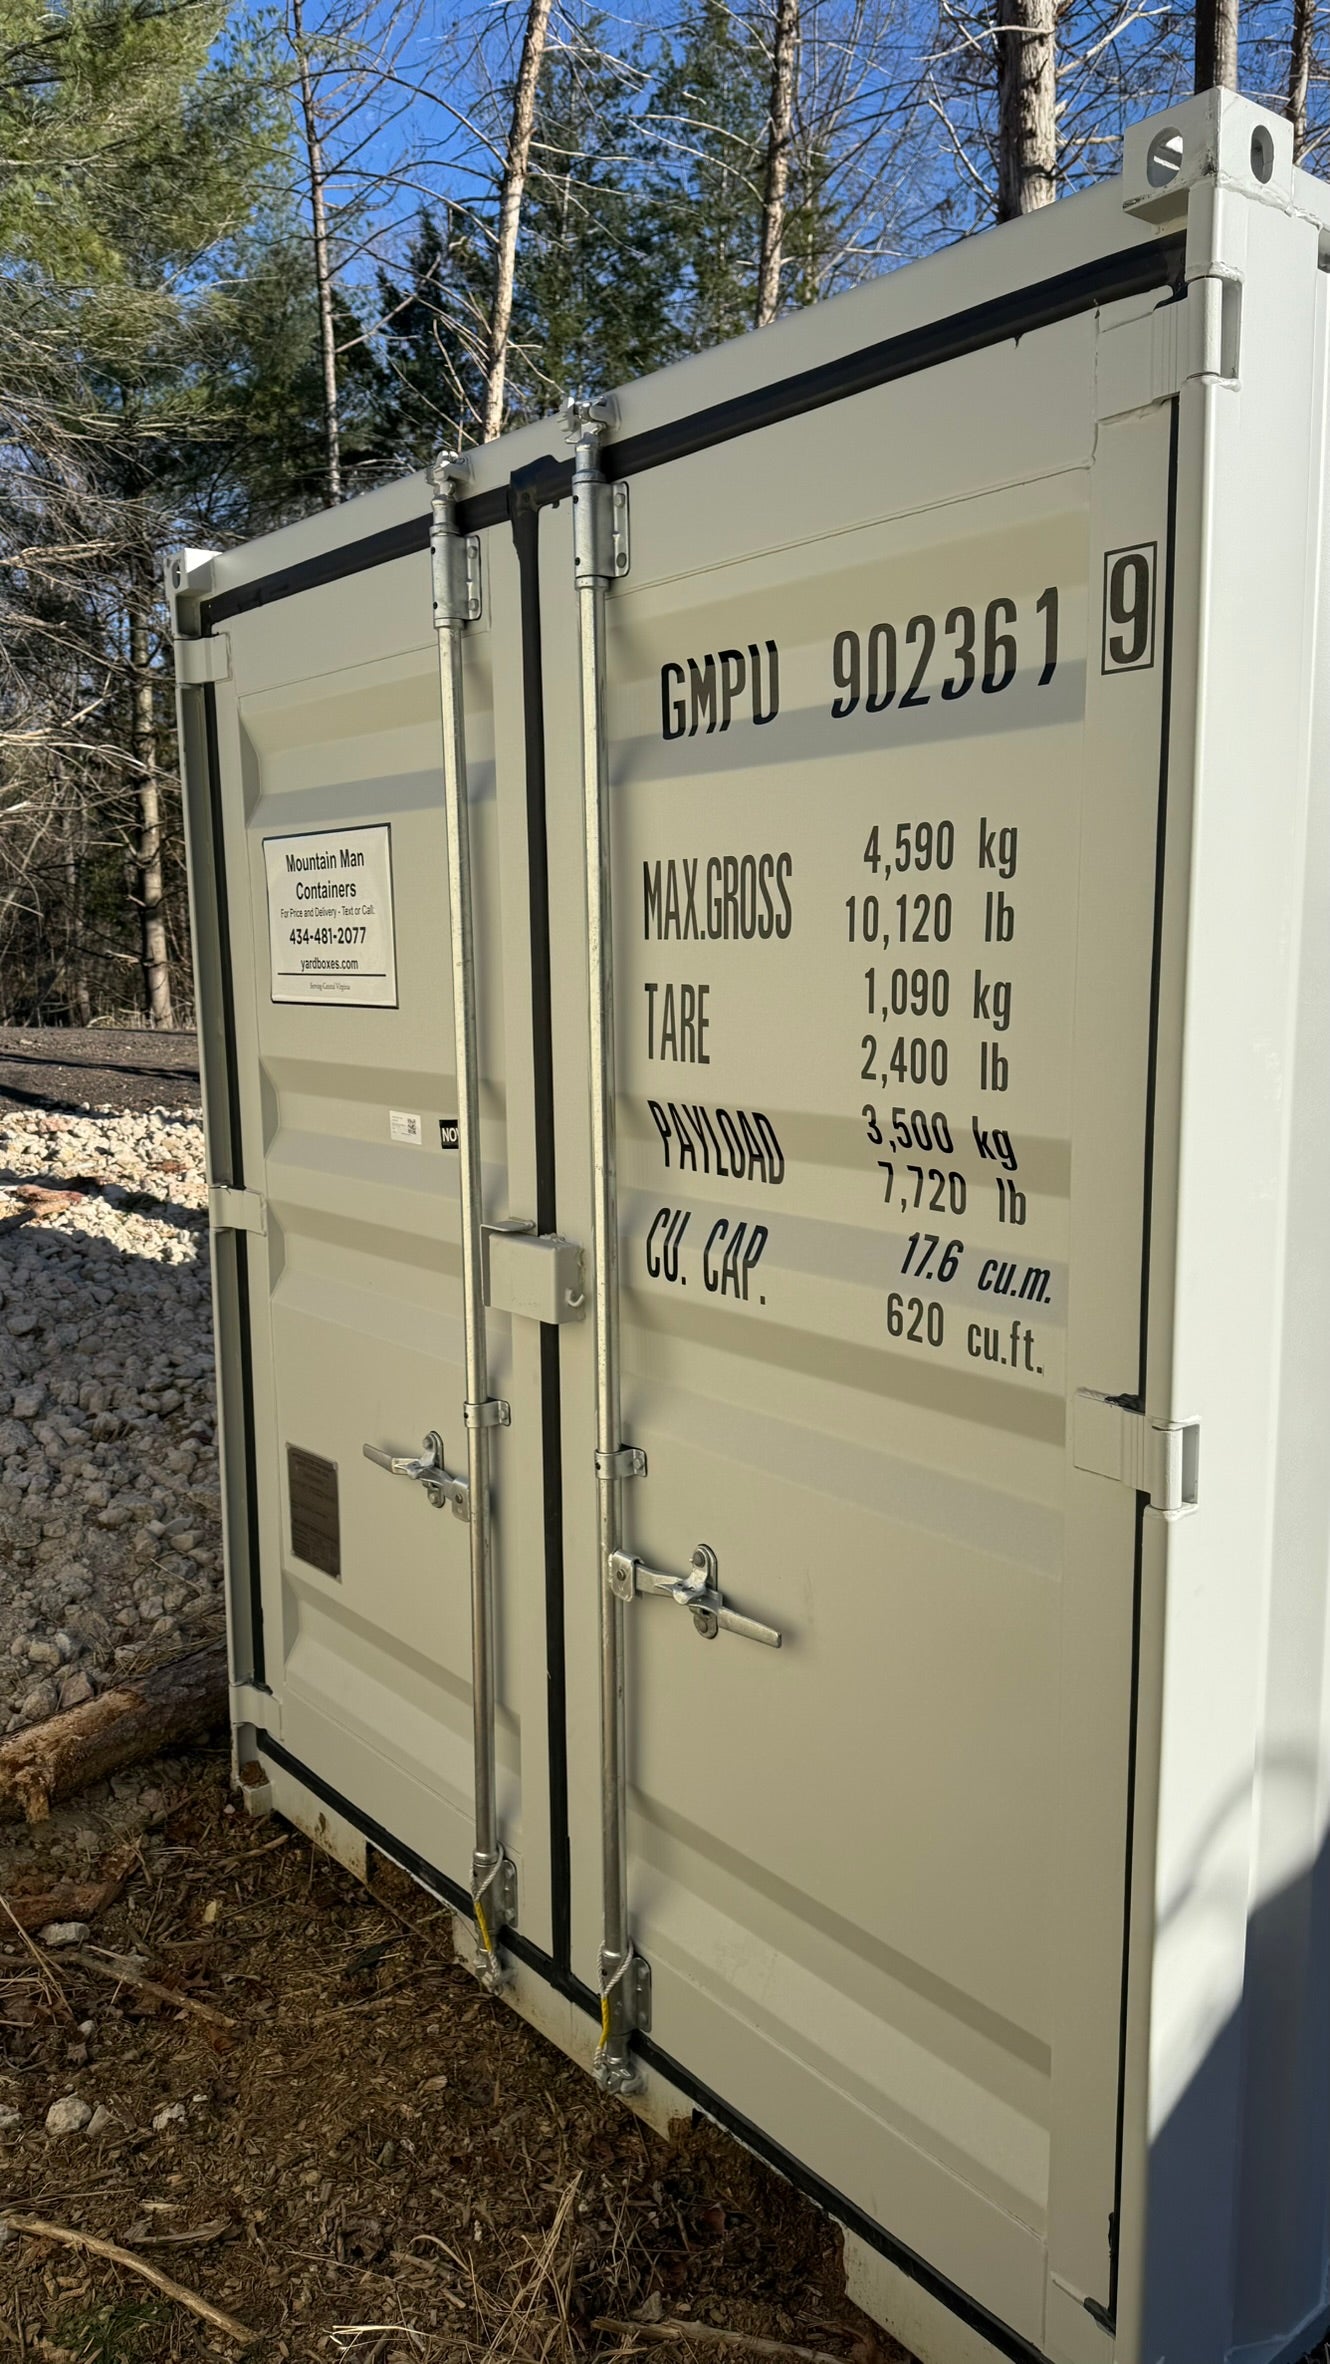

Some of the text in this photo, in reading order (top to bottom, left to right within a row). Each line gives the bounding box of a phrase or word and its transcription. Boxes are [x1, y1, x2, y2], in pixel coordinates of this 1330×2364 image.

[660, 553, 1151, 741] GMPU 902361 9
[285, 849, 365, 872] Mountain Man
[862, 816, 1018, 881] 4,590 kg
[289, 908, 303, 918] Price
[303, 907, 314, 917] and
[314, 906, 337, 919] Delivery
[341, 905, 353, 916] Text
[354, 907, 361, 915] or
[295, 880, 357, 900] Containers
[642, 851, 793, 941] MAX.GROSS
[845, 890, 1015, 951] 10,120 lb
[289, 926, 366, 944] 434-481-2077
[300, 957, 359, 972] yardboxes.com
[644, 982, 711, 1065] TARE
[864, 967, 1012, 1032] 1,090 kg
[860, 1033, 1009, 1093] 2,400 lb
[646, 1099, 786, 1185] PAYLOAD
[861, 1103, 1018, 1172] 3,500 kg
[876, 1160, 1027, 1226] 7,720 lb
[645, 1207, 769, 1306] CU. CAP.
[900, 1231, 1052, 1305] 17.6 cu.m.
[886, 1292, 1044, 1376] 620 cu.ft.
